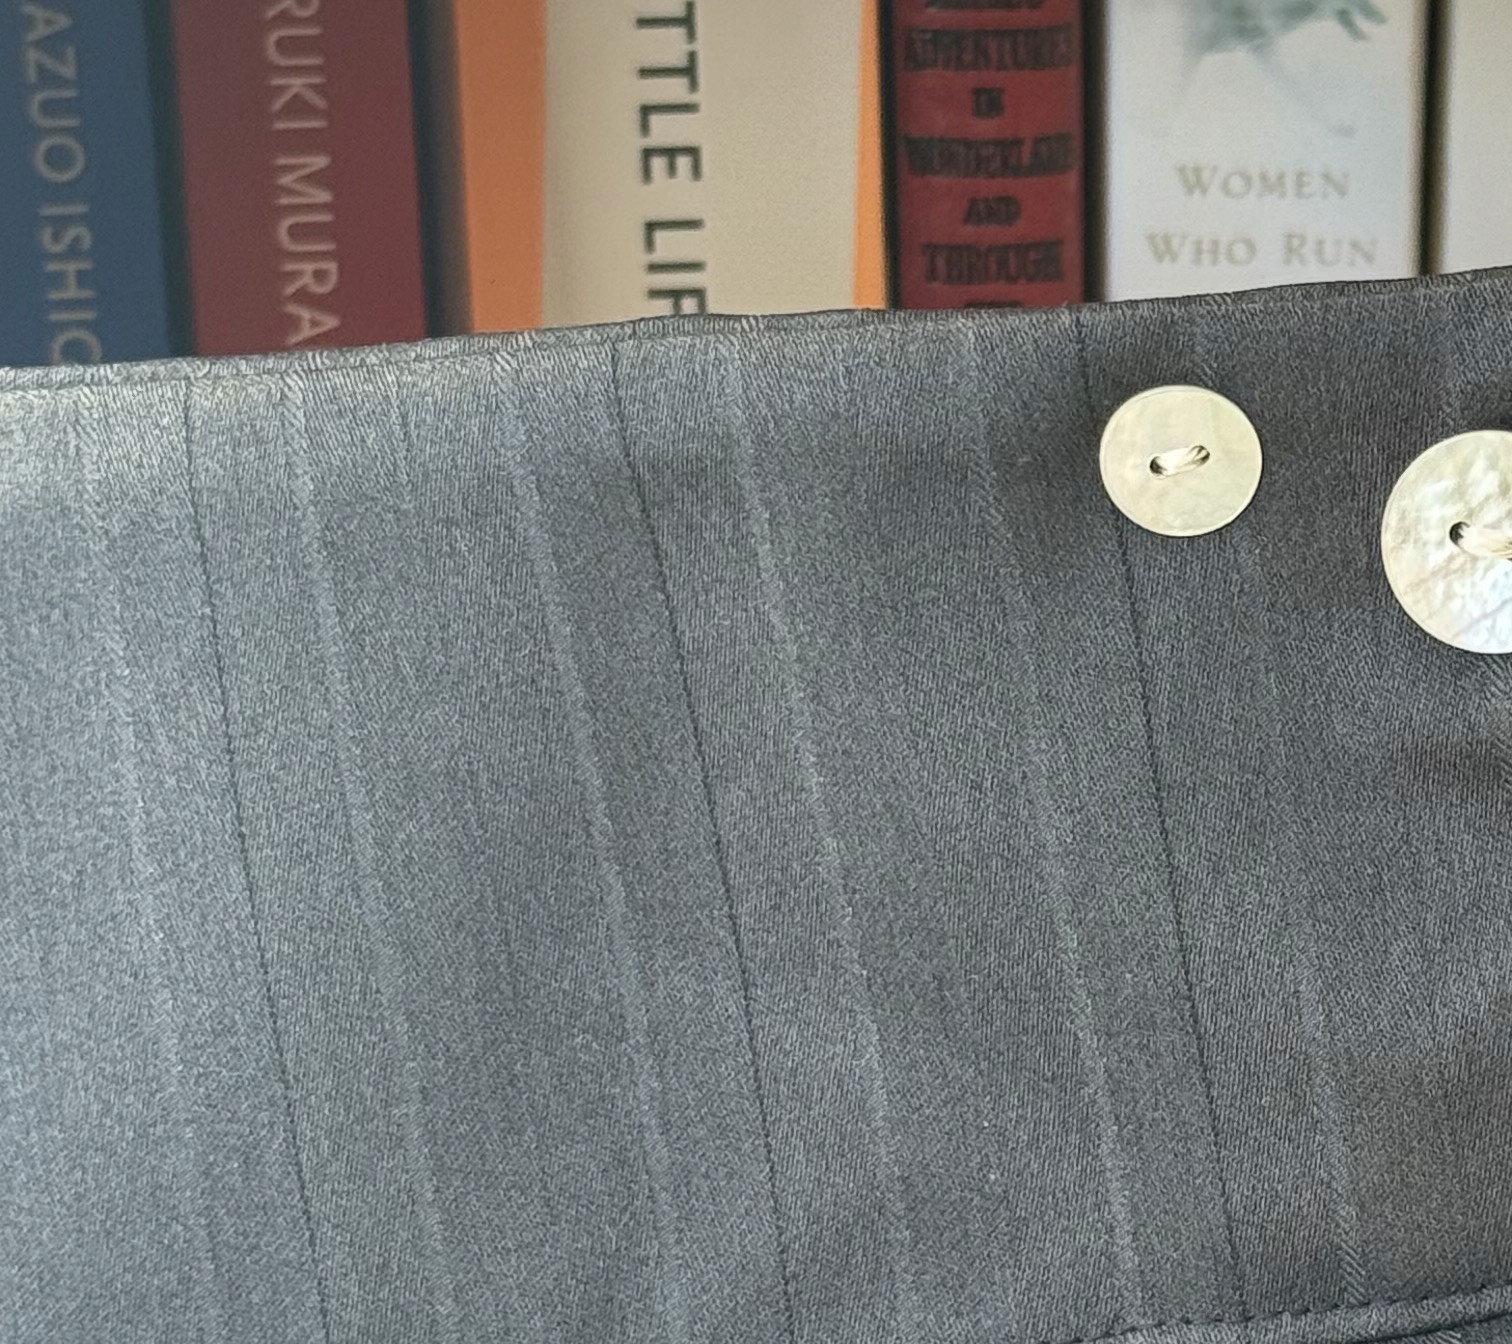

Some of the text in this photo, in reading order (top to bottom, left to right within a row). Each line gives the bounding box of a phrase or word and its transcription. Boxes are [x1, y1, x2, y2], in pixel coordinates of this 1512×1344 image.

[962, 196, 1022, 227] AND
[272, 154, 342, 346] MURA
[921, 240, 1064, 285] THROUGH
